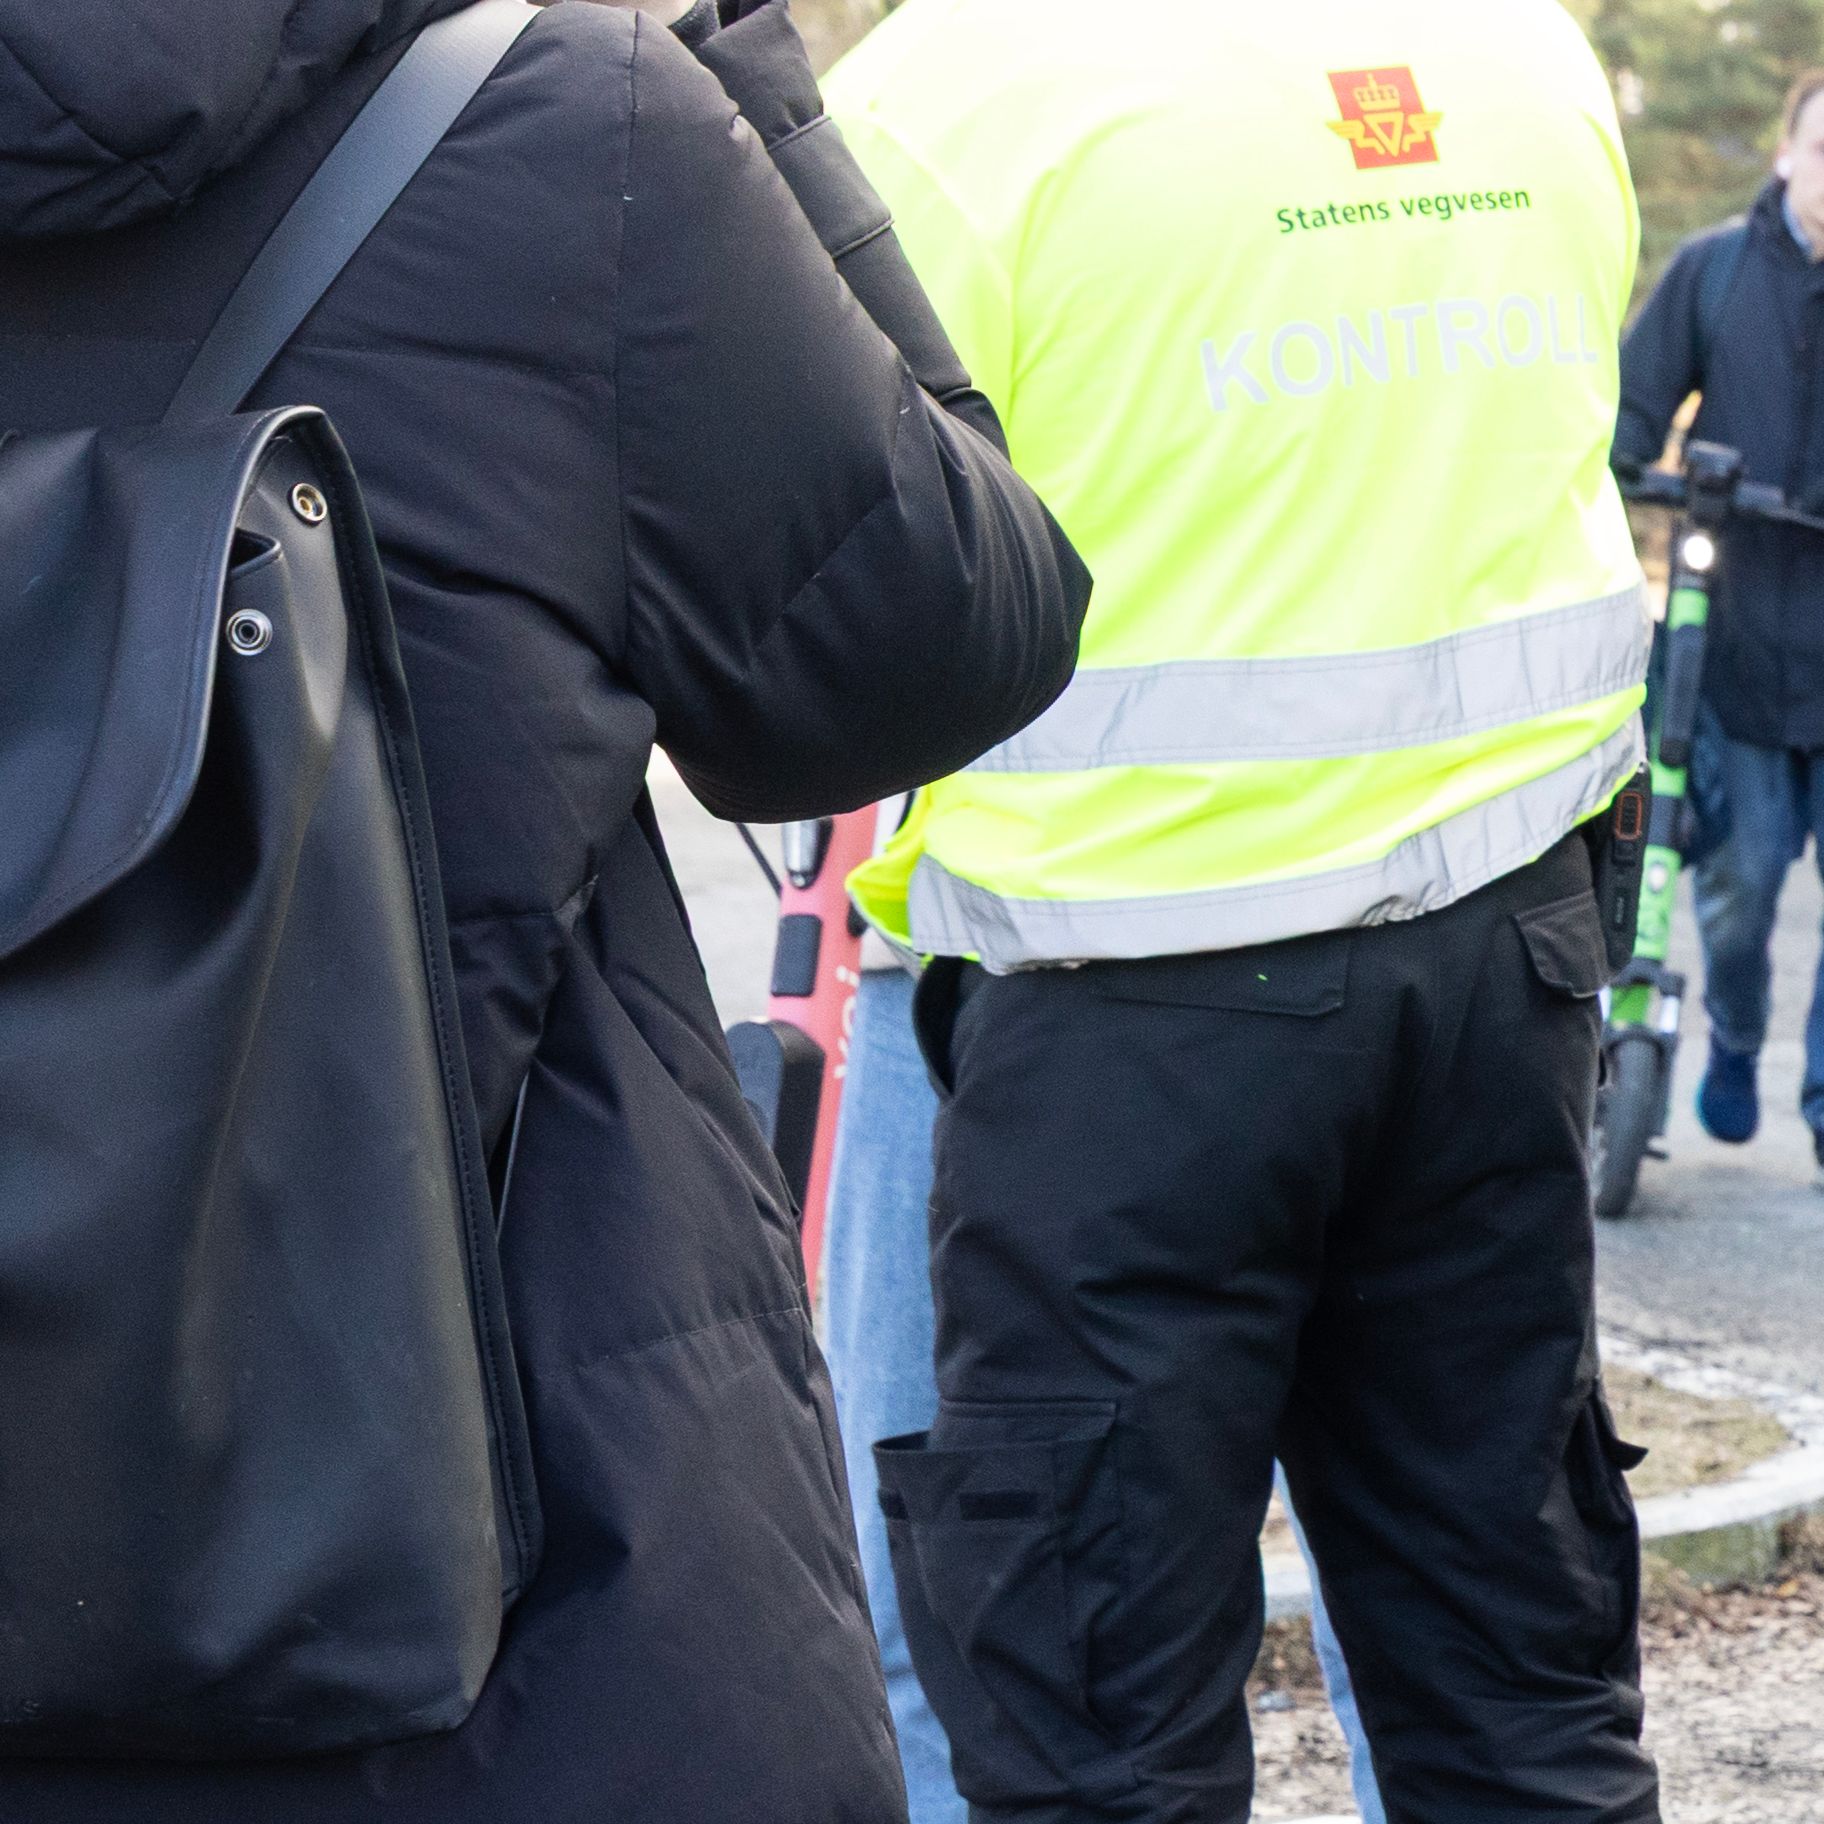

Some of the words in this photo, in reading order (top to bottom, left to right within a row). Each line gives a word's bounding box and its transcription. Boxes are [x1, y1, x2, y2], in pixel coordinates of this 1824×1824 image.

[1276, 200, 1391, 233] Statens
[1399, 190, 1531, 220] vegvesen
[1200, 293, 1599, 413] KONTROLL
